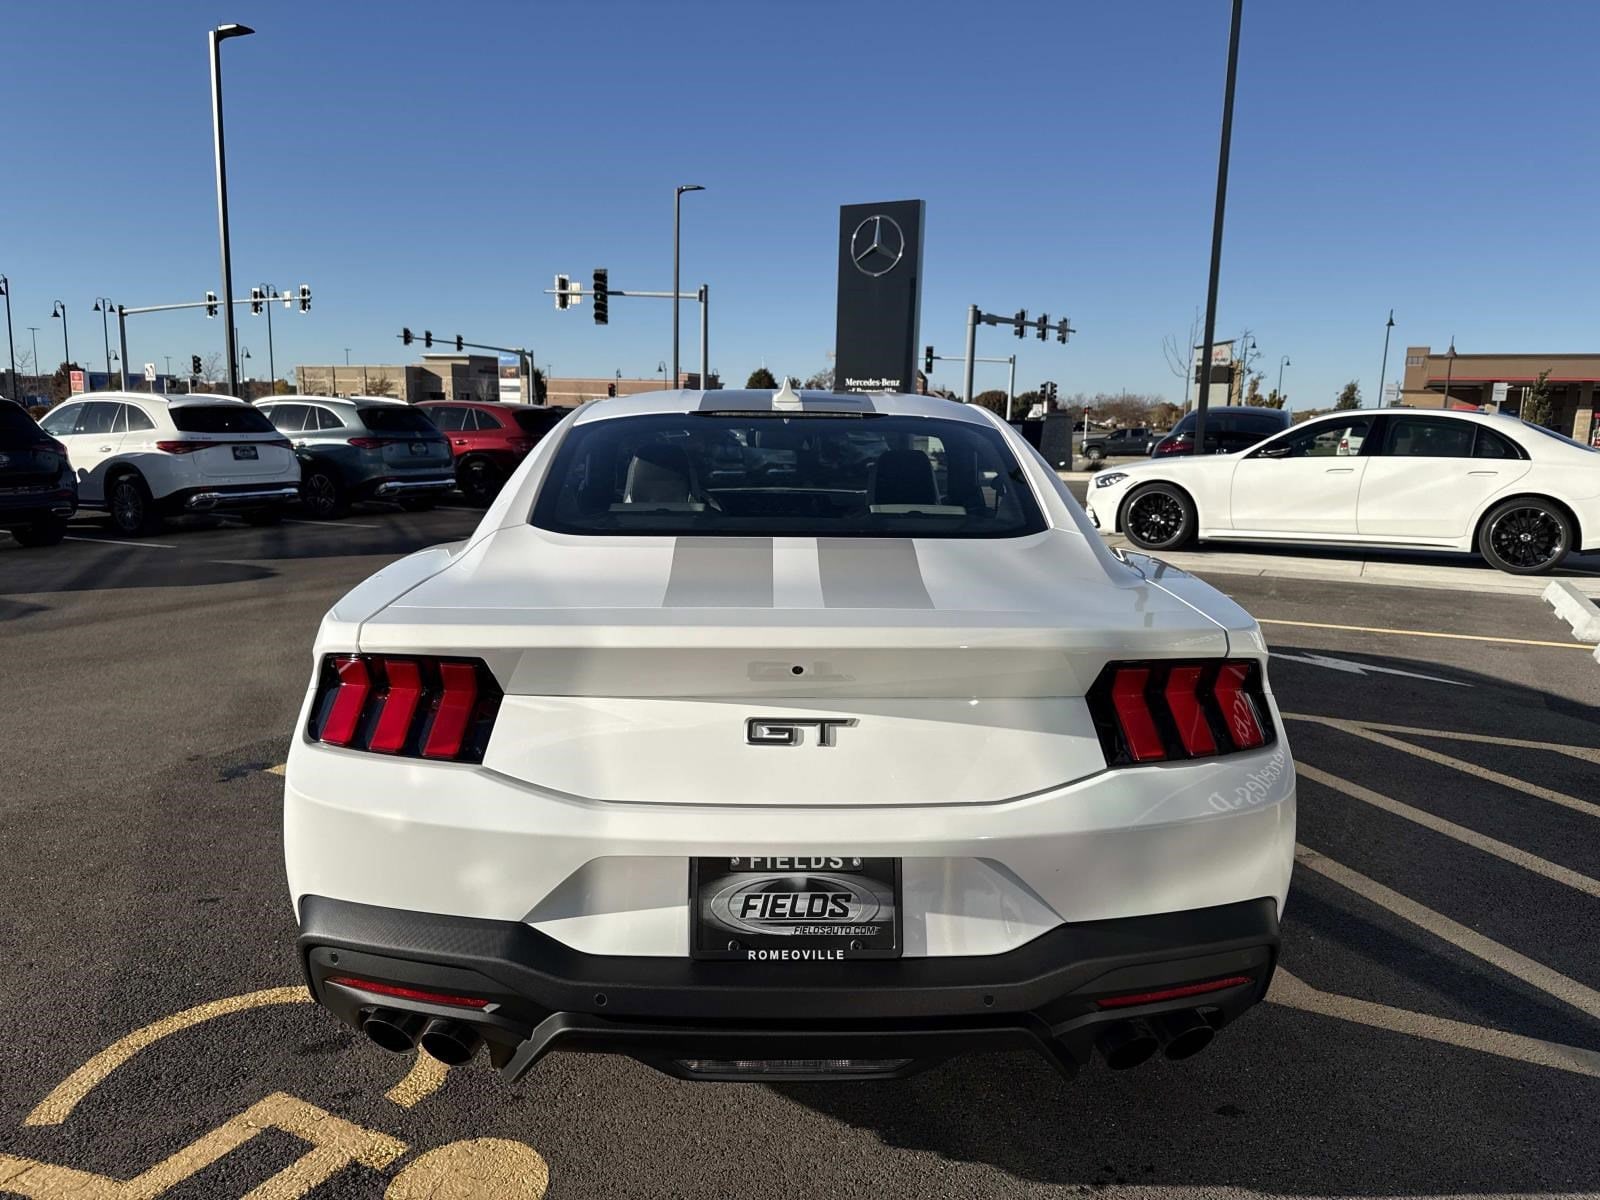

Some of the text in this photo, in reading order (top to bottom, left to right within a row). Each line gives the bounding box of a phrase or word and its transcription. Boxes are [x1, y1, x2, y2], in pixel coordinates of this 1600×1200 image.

[845, 378, 900, 387] Mercedes-Benz
[743, 717, 860, 747] GT
[750, 857, 844, 869] FIELDS
[740, 894, 851, 919] FIELDS
[748, 950, 844, 960] ROMEOVILLE
